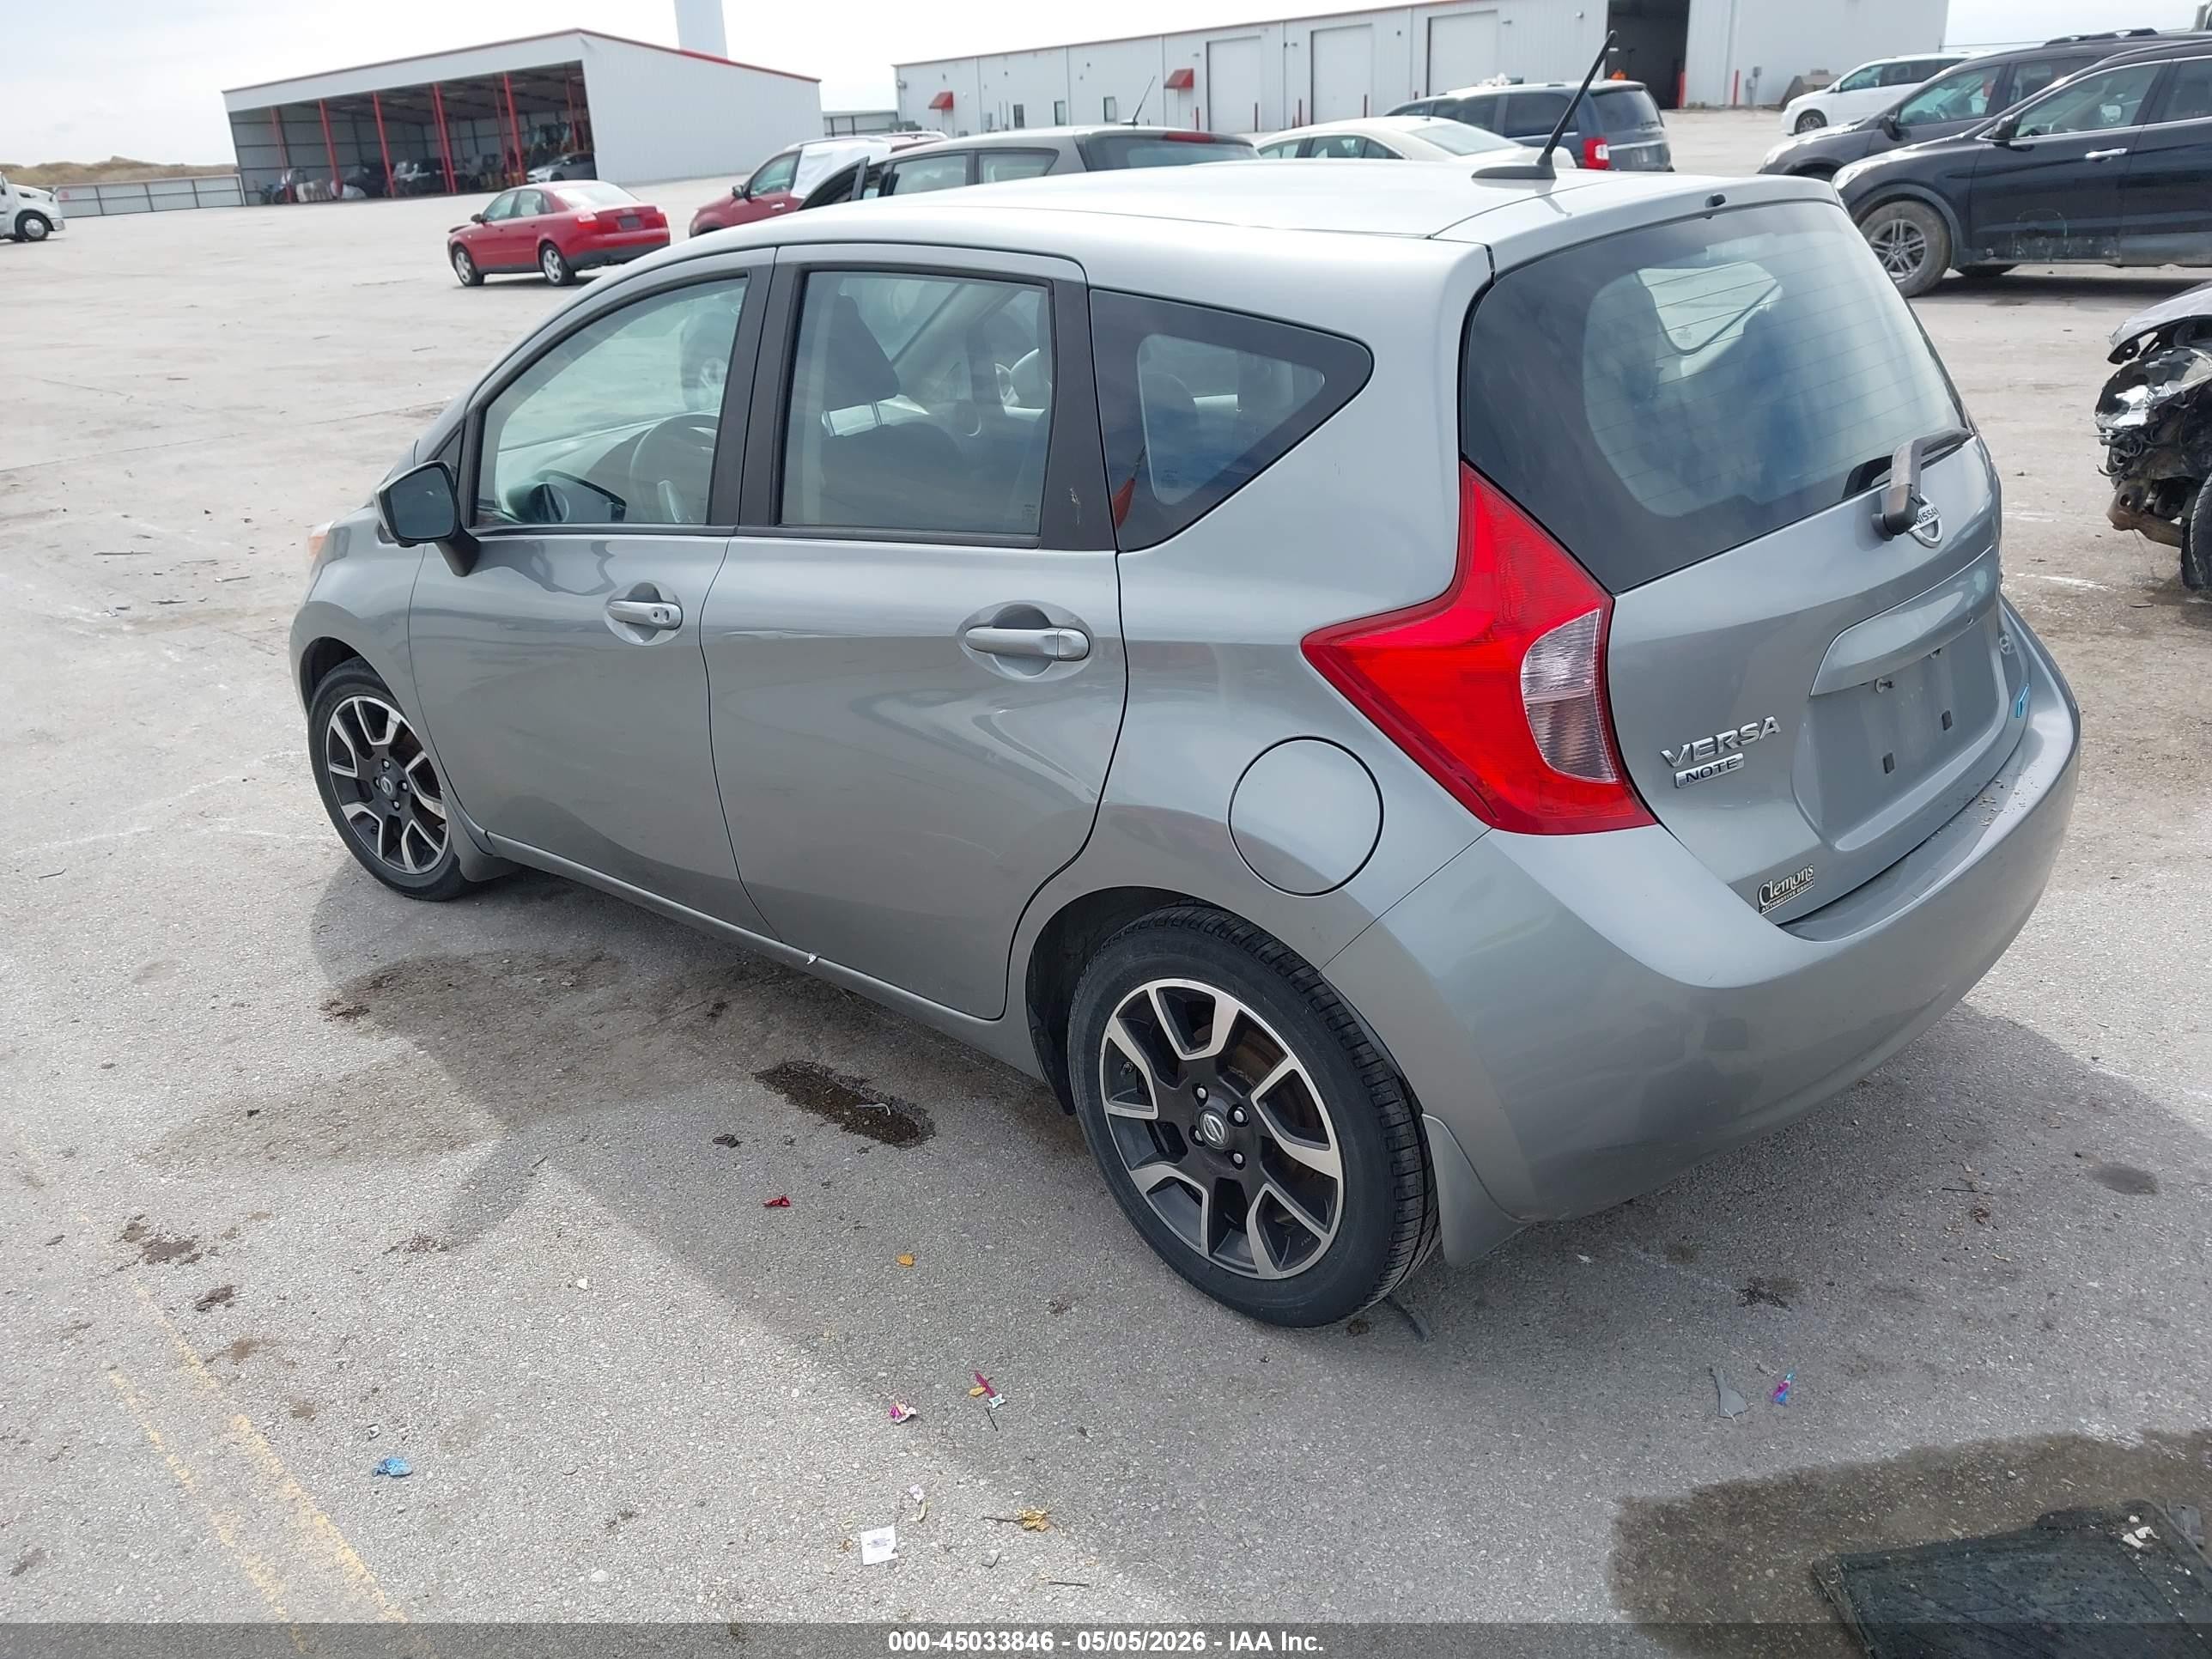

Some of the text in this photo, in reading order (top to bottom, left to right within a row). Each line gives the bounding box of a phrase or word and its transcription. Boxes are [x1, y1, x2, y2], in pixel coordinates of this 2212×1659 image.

[1661, 715, 1782, 768] VERSA
[1685, 757, 1738, 783] NOTE
[1759, 864, 1814, 906] Clemons
